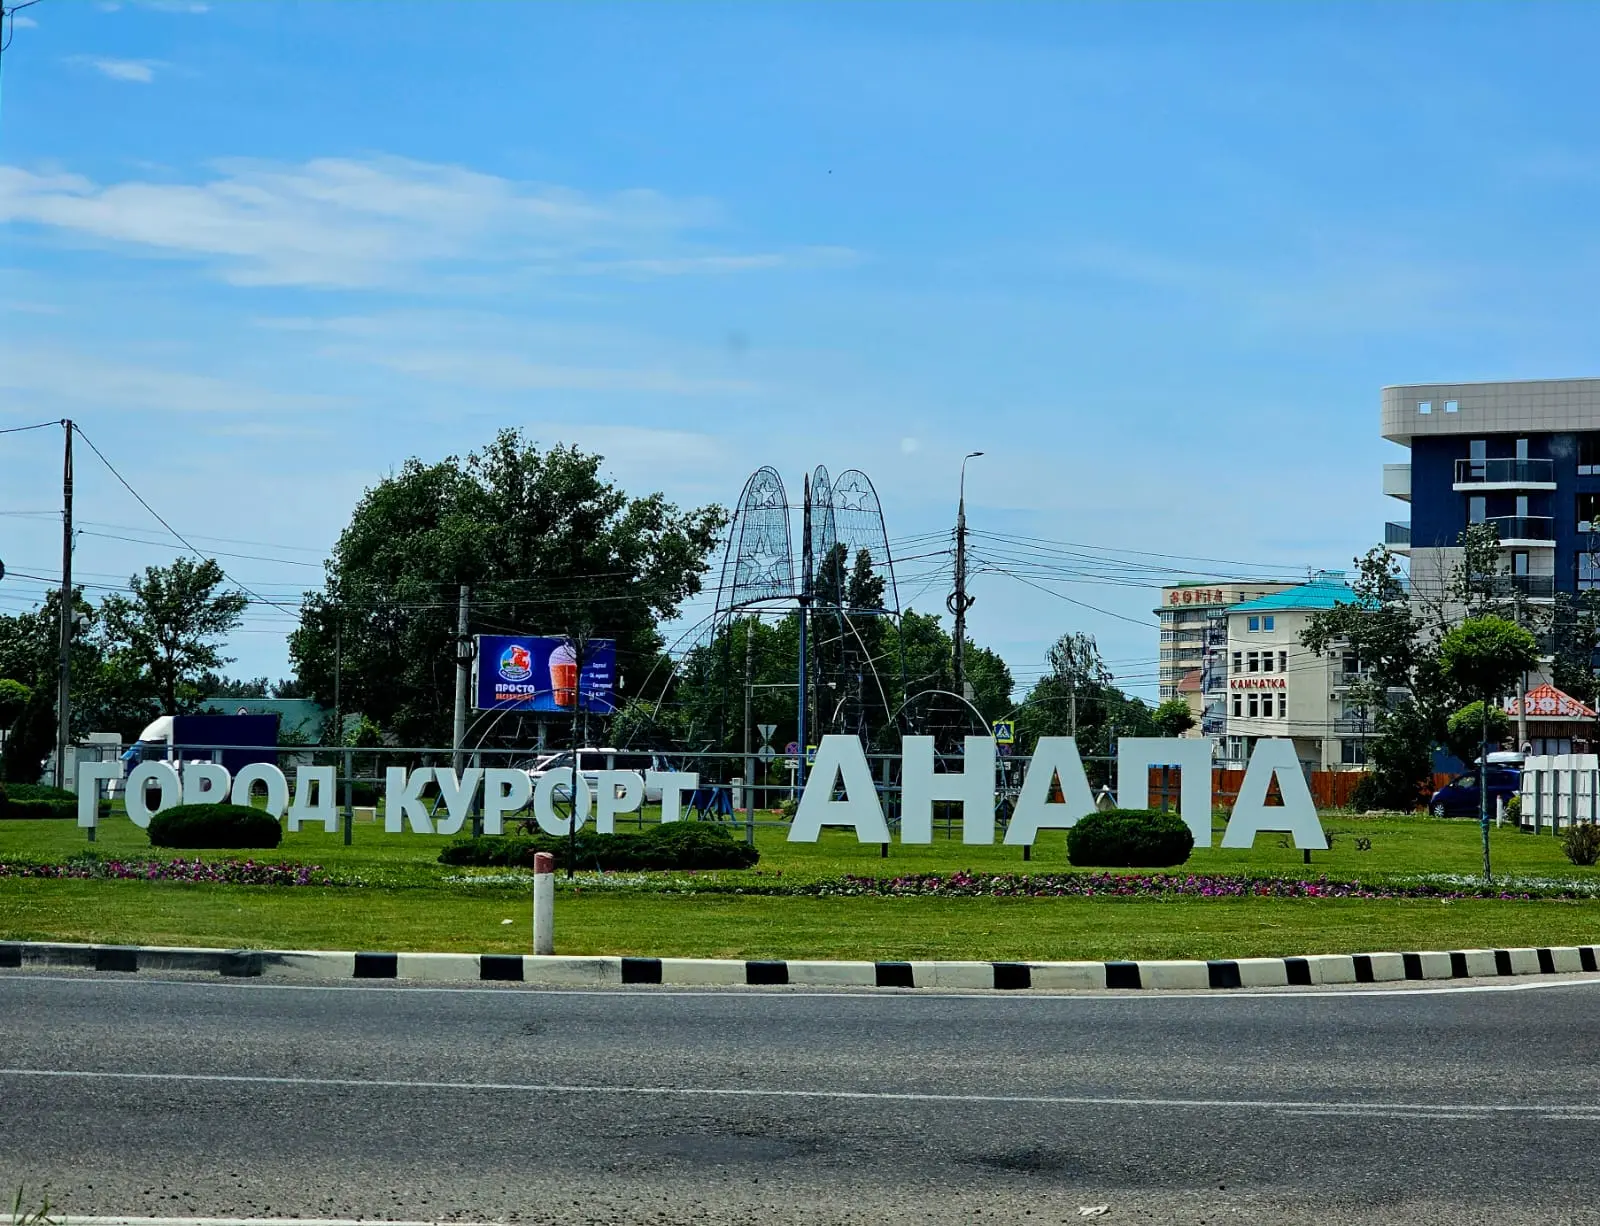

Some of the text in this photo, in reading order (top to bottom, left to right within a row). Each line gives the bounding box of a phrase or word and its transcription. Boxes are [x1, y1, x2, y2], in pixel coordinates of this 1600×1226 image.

[495, 683, 535, 693] ПРОСТО
[1230, 678, 1287, 690] КАМЧАТКА
[77, 735, 1329, 850] ГОРОД КУРОРТ АНАПА
